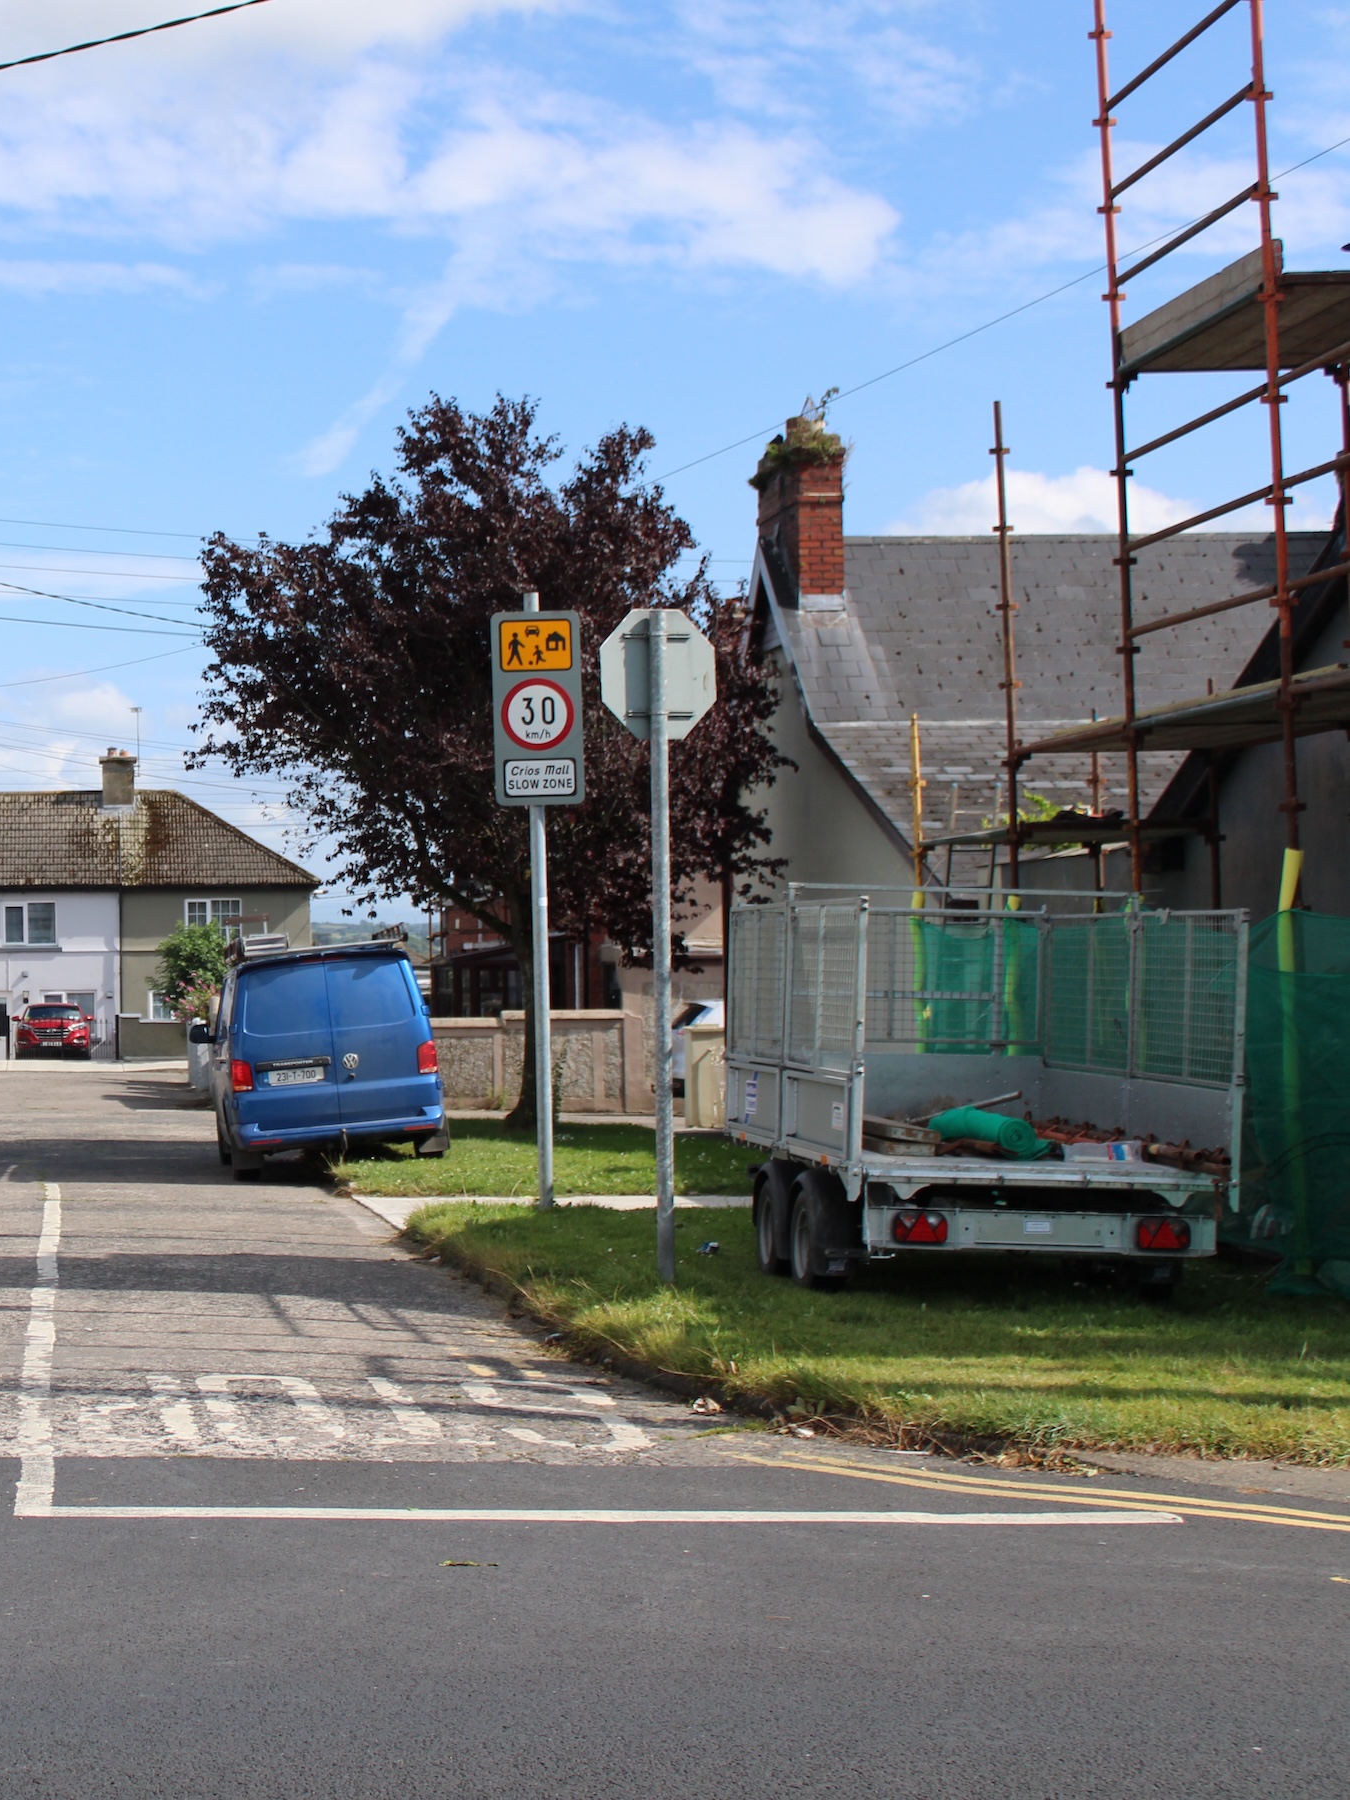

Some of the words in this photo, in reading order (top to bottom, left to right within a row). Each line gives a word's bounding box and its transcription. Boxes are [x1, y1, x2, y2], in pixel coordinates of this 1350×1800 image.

[521, 696, 555, 726] 30
[525, 729, 551, 740] km/h
[511, 765, 540, 776] Crios
[544, 764, 569, 776] Mall
[508, 779, 540, 790] SLOW
[542, 778, 573, 789] ZONE
[276, 1069, 316, 1082] 231-T-700
